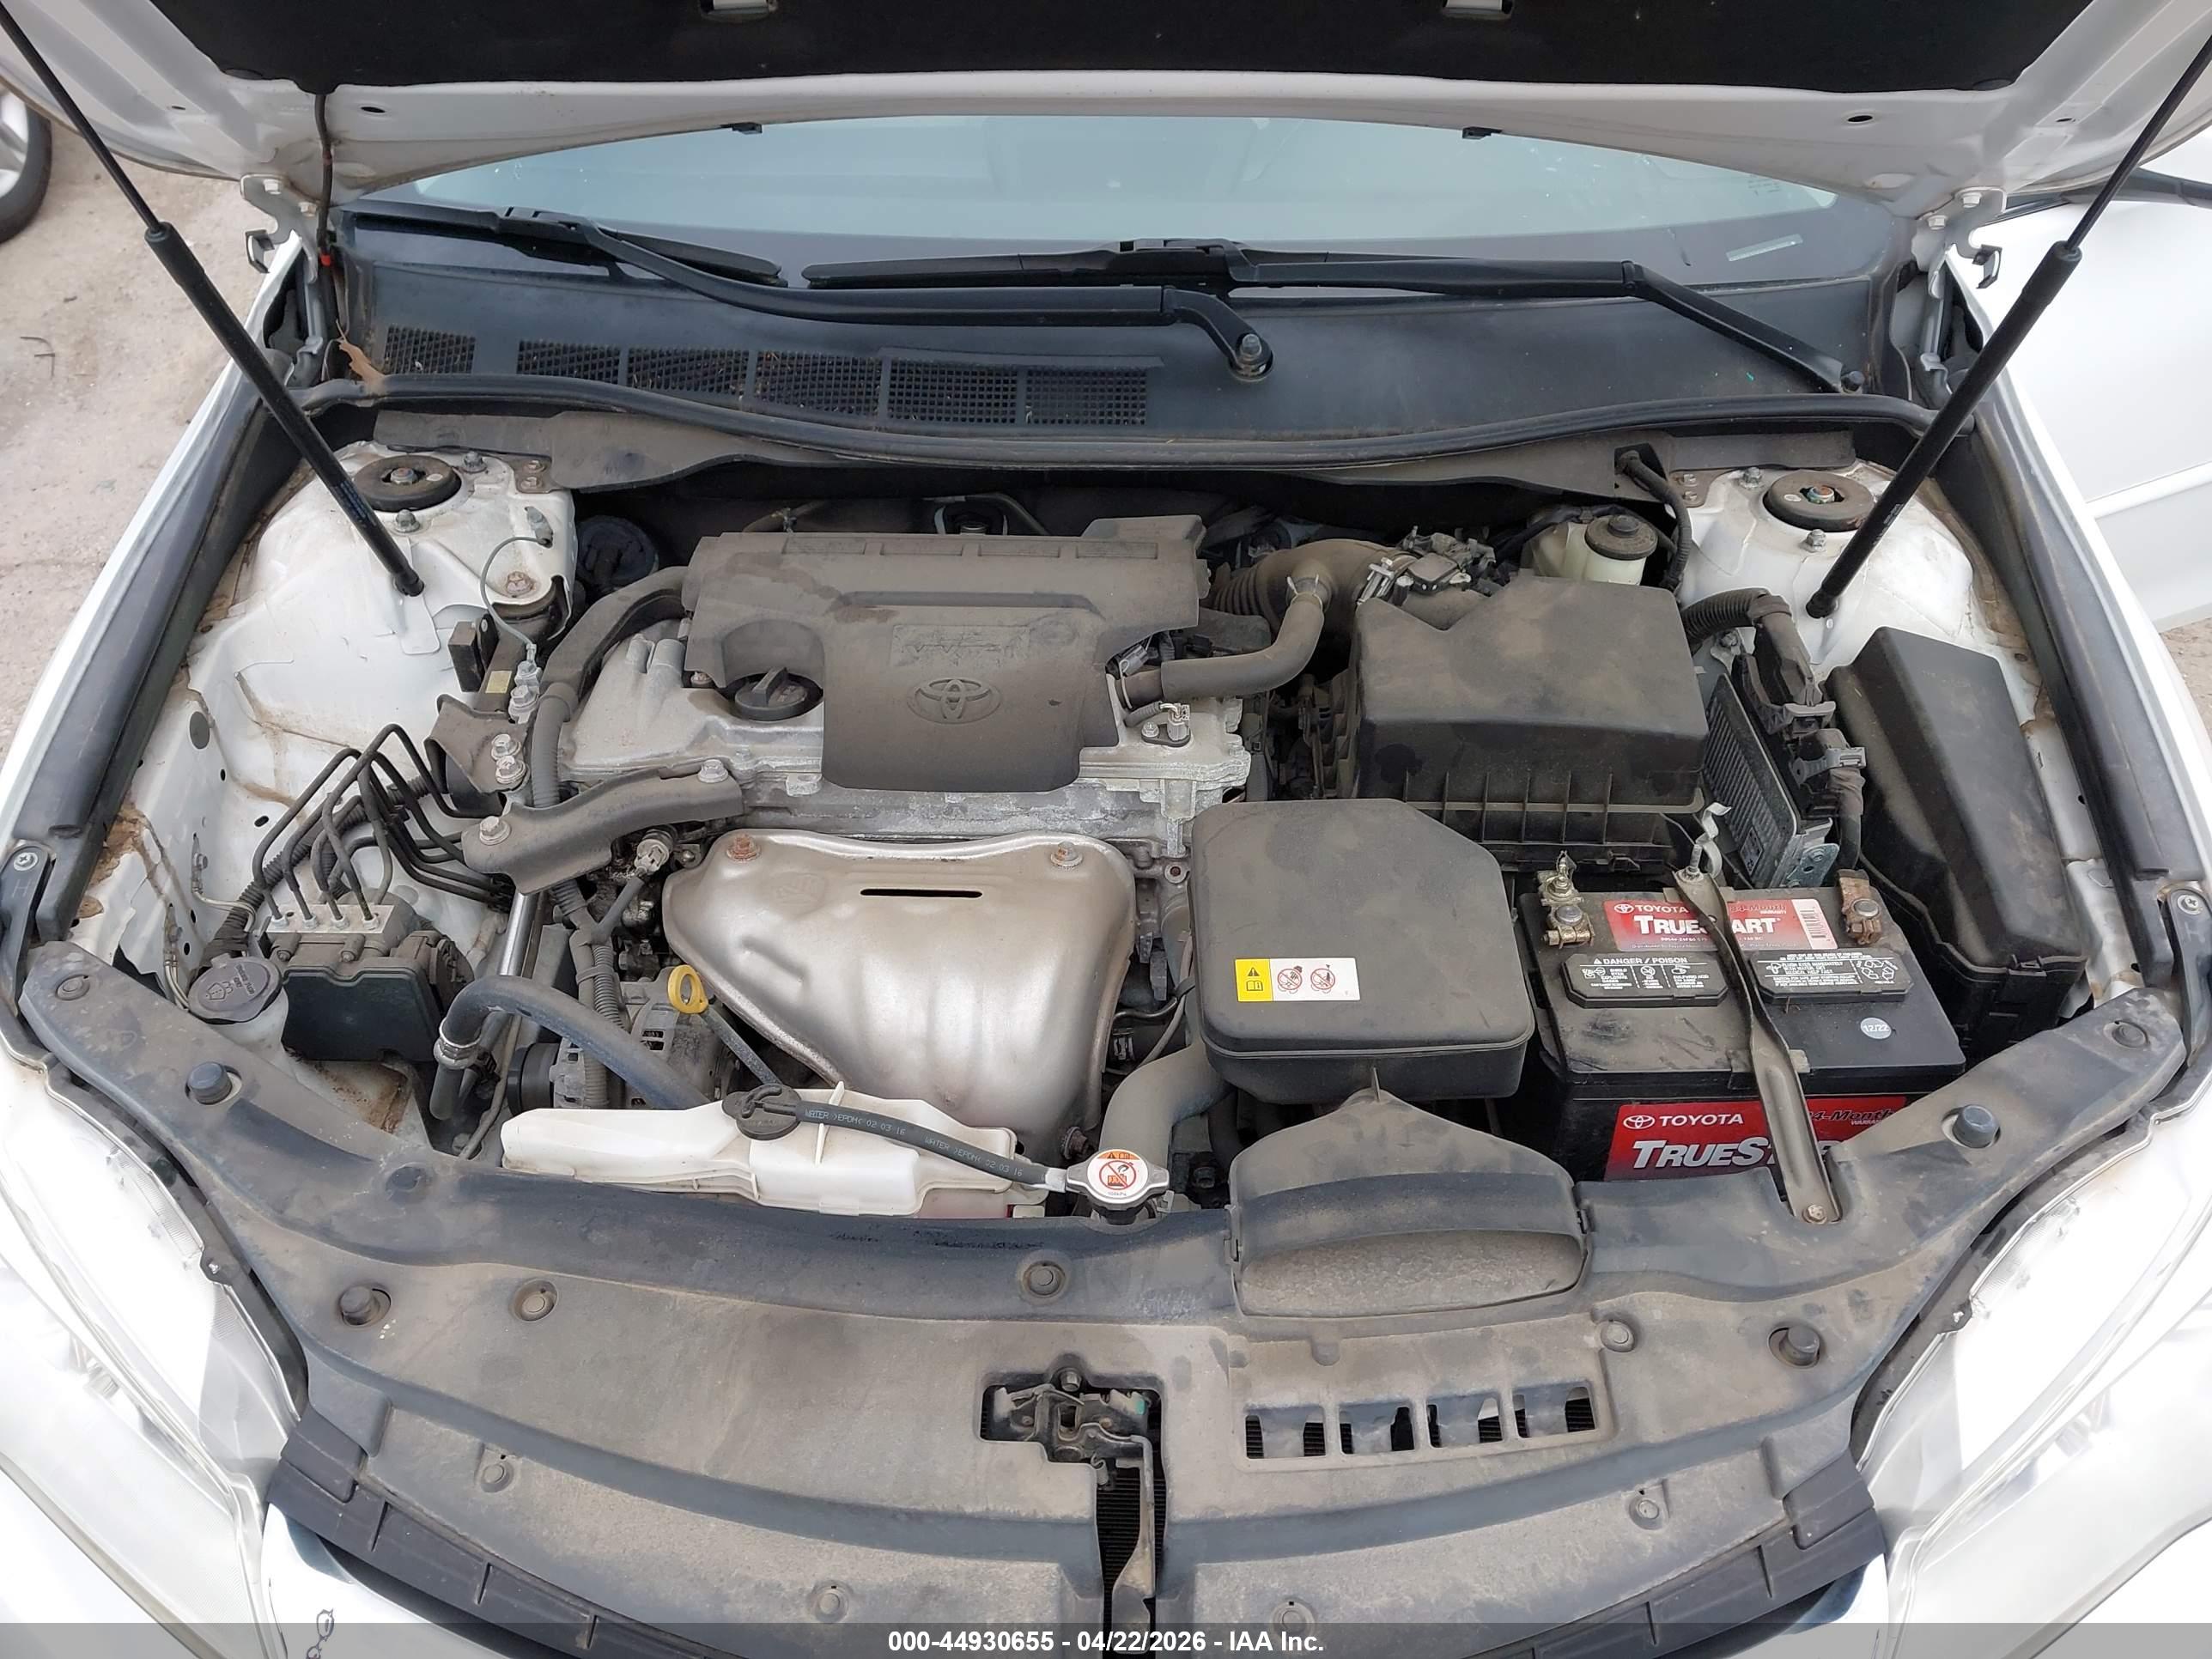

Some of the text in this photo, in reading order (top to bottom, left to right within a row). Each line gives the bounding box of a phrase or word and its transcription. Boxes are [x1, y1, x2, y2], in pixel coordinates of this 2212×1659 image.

[1635, 904, 1689, 914] TOYOTA
[805, 1109, 830, 1120] WATER
[866, 1120, 878, 1128] 02
[880, 1123, 893, 1132] 03
[896, 1127, 906, 1135] 16
[1659, 1113, 1744, 1127] TOYOTA
[1809, 1109, 1895, 1121] 4-Month
[924, 1136, 950, 1151] WATER
[985, 1160, 996, 1169] 02
[999, 1164, 1010, 1173] 03
[1014, 1167, 1023, 1176] 16
